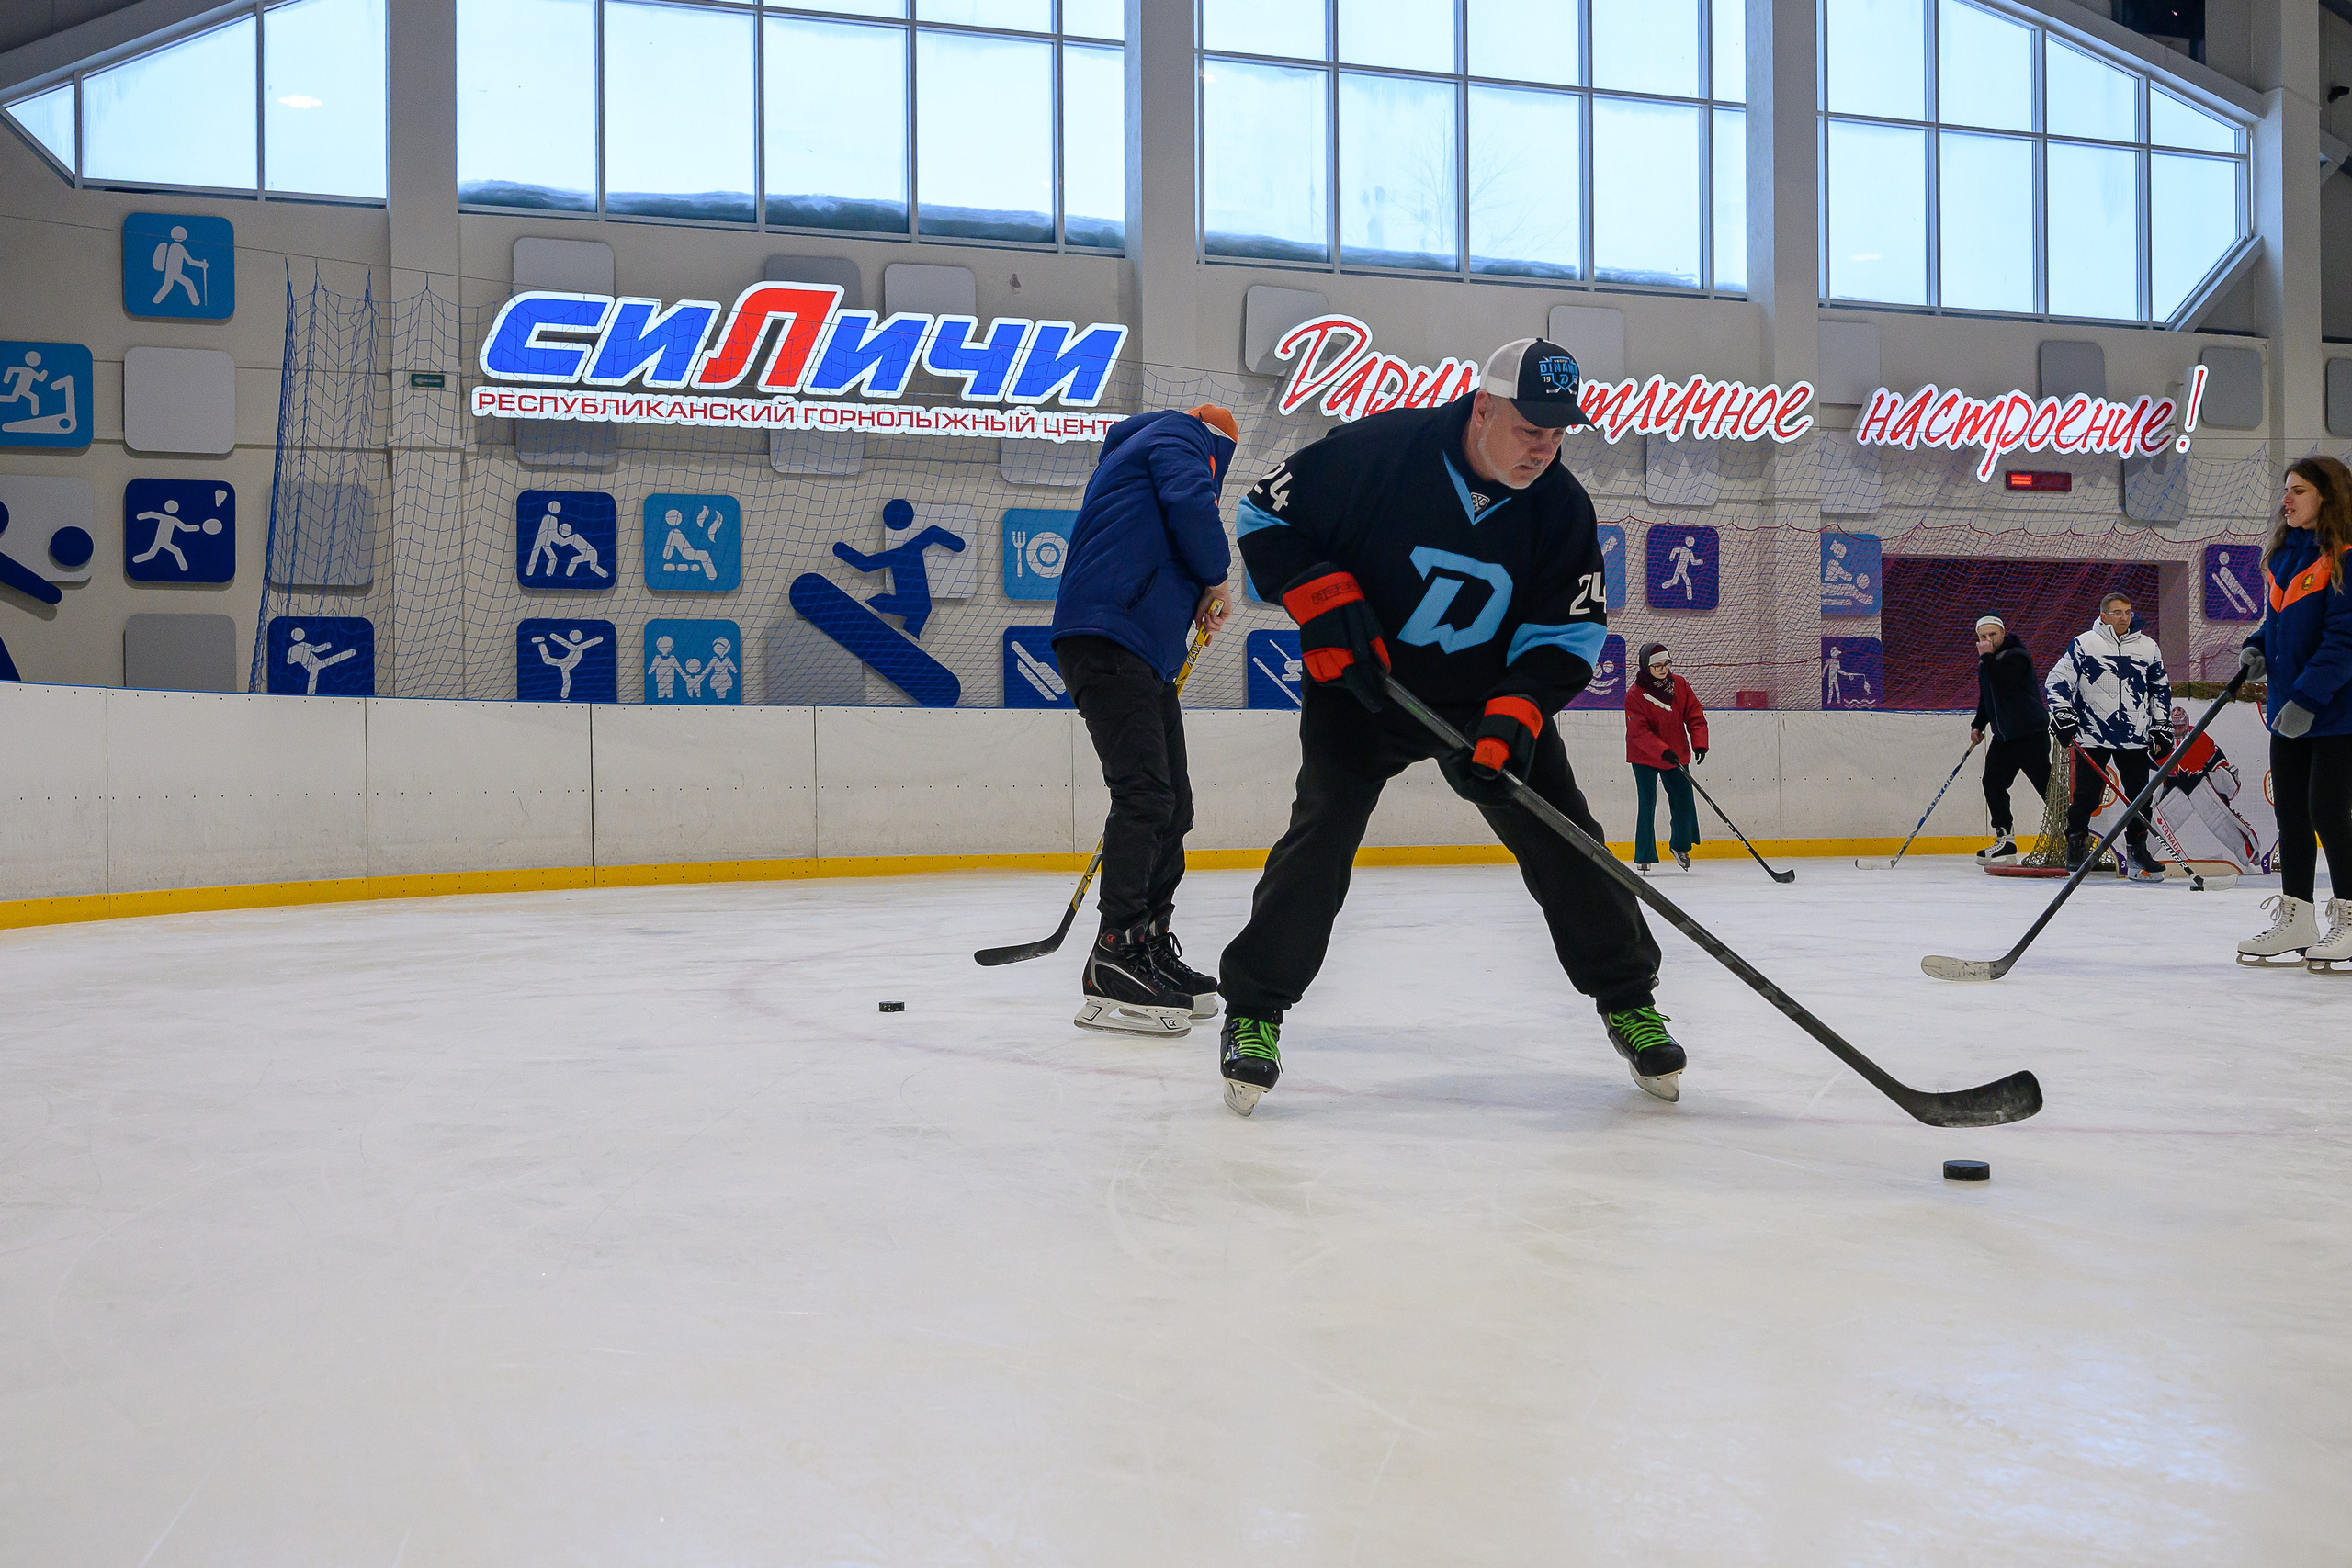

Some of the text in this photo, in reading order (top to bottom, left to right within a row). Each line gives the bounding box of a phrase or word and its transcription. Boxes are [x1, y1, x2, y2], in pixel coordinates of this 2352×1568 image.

[478, 392, 1119, 437] РЕСПУБЛИКАНСКИЙ ГОРНОЛЫЖНЫЙ ЦЕНТ
[1572, 378, 1809, 439] тличное
[1253, 461, 1293, 512] 24
[1569, 571, 1607, 615] 24
[1186, 641, 1202, 669] MAX
[2161, 824, 2182, 855] CANADA
[2263, 859, 2268, 867] 5
